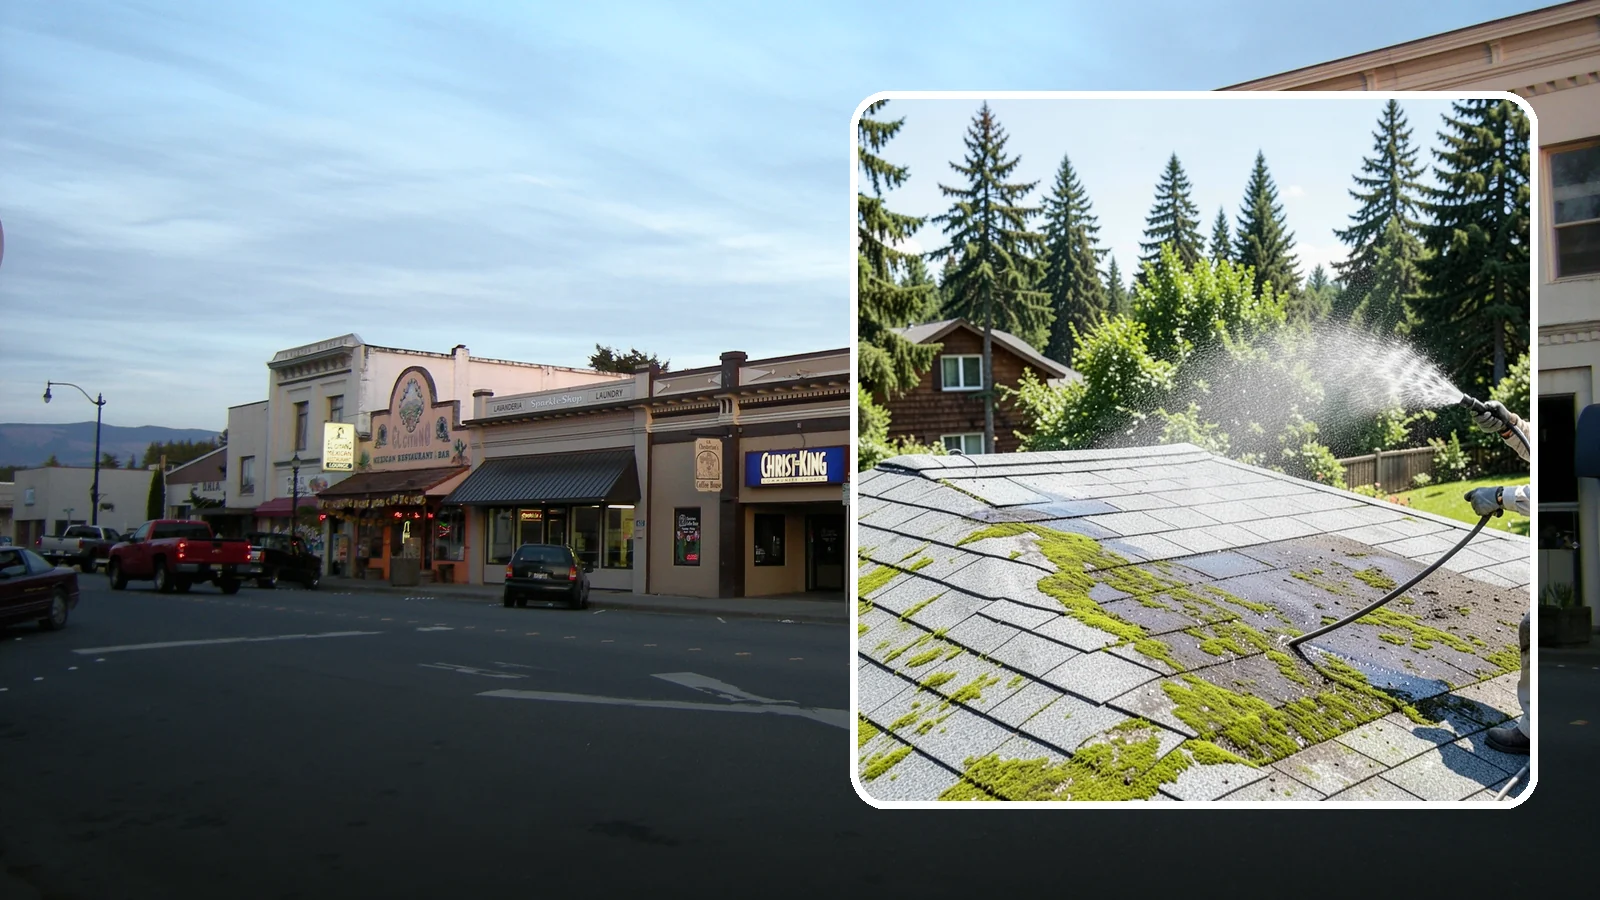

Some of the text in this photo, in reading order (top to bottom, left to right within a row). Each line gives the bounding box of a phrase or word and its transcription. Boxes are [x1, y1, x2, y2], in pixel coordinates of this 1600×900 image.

[595, 389, 623, 399] LAUNDRY
[493, 402, 522, 412] LAVANDERIA
[530, 394, 582, 409] Sparkle Shop
[374, 450, 450, 464] MEXICAN RESTAURANT BAR
[761, 450, 827, 478] CHRIST KING
